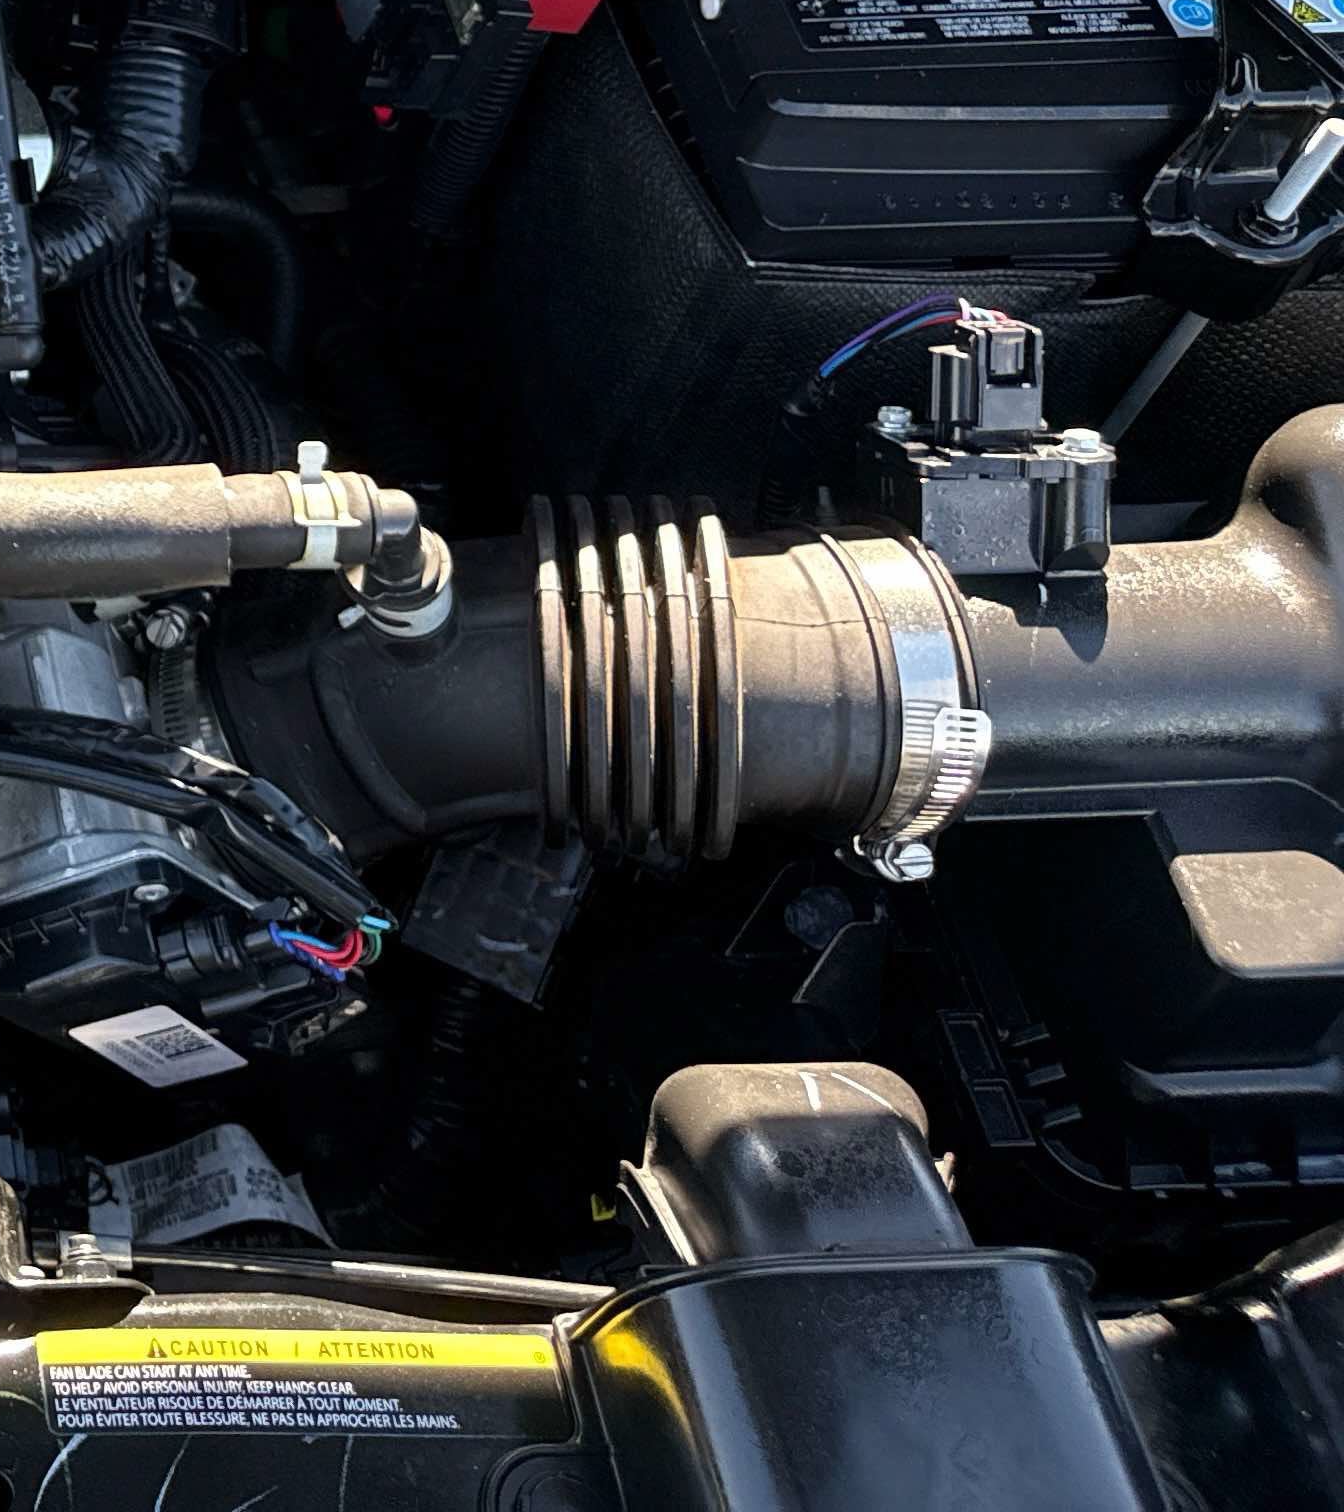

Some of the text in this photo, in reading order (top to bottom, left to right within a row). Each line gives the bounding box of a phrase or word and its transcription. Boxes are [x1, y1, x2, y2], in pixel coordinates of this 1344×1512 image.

[170, 1340, 269, 1357] CAUTION
[318, 1341, 435, 1360] ATTENTION
[49, 1365, 74, 1380] FAN
[75, 1365, 113, 1379] BLADE
[114, 1364, 141, 1379] CAN
[142, 1364, 177, 1379] START
[179, 1364, 194, 1378] AT
[52, 1380, 358, 1396] TO HELP AVOID PERSONAL INJURY, KEEP HANDS CLEAR.
[55, 1394, 404, 1413] LE VENTILATEUR RISQUE DE DÉMARRER À TOUT MOMENT.
[57, 1409, 462, 1429] POUR ÉVITER TOUTE BLESSURE, NE PAS EN APPROCHER LES MAINS.
